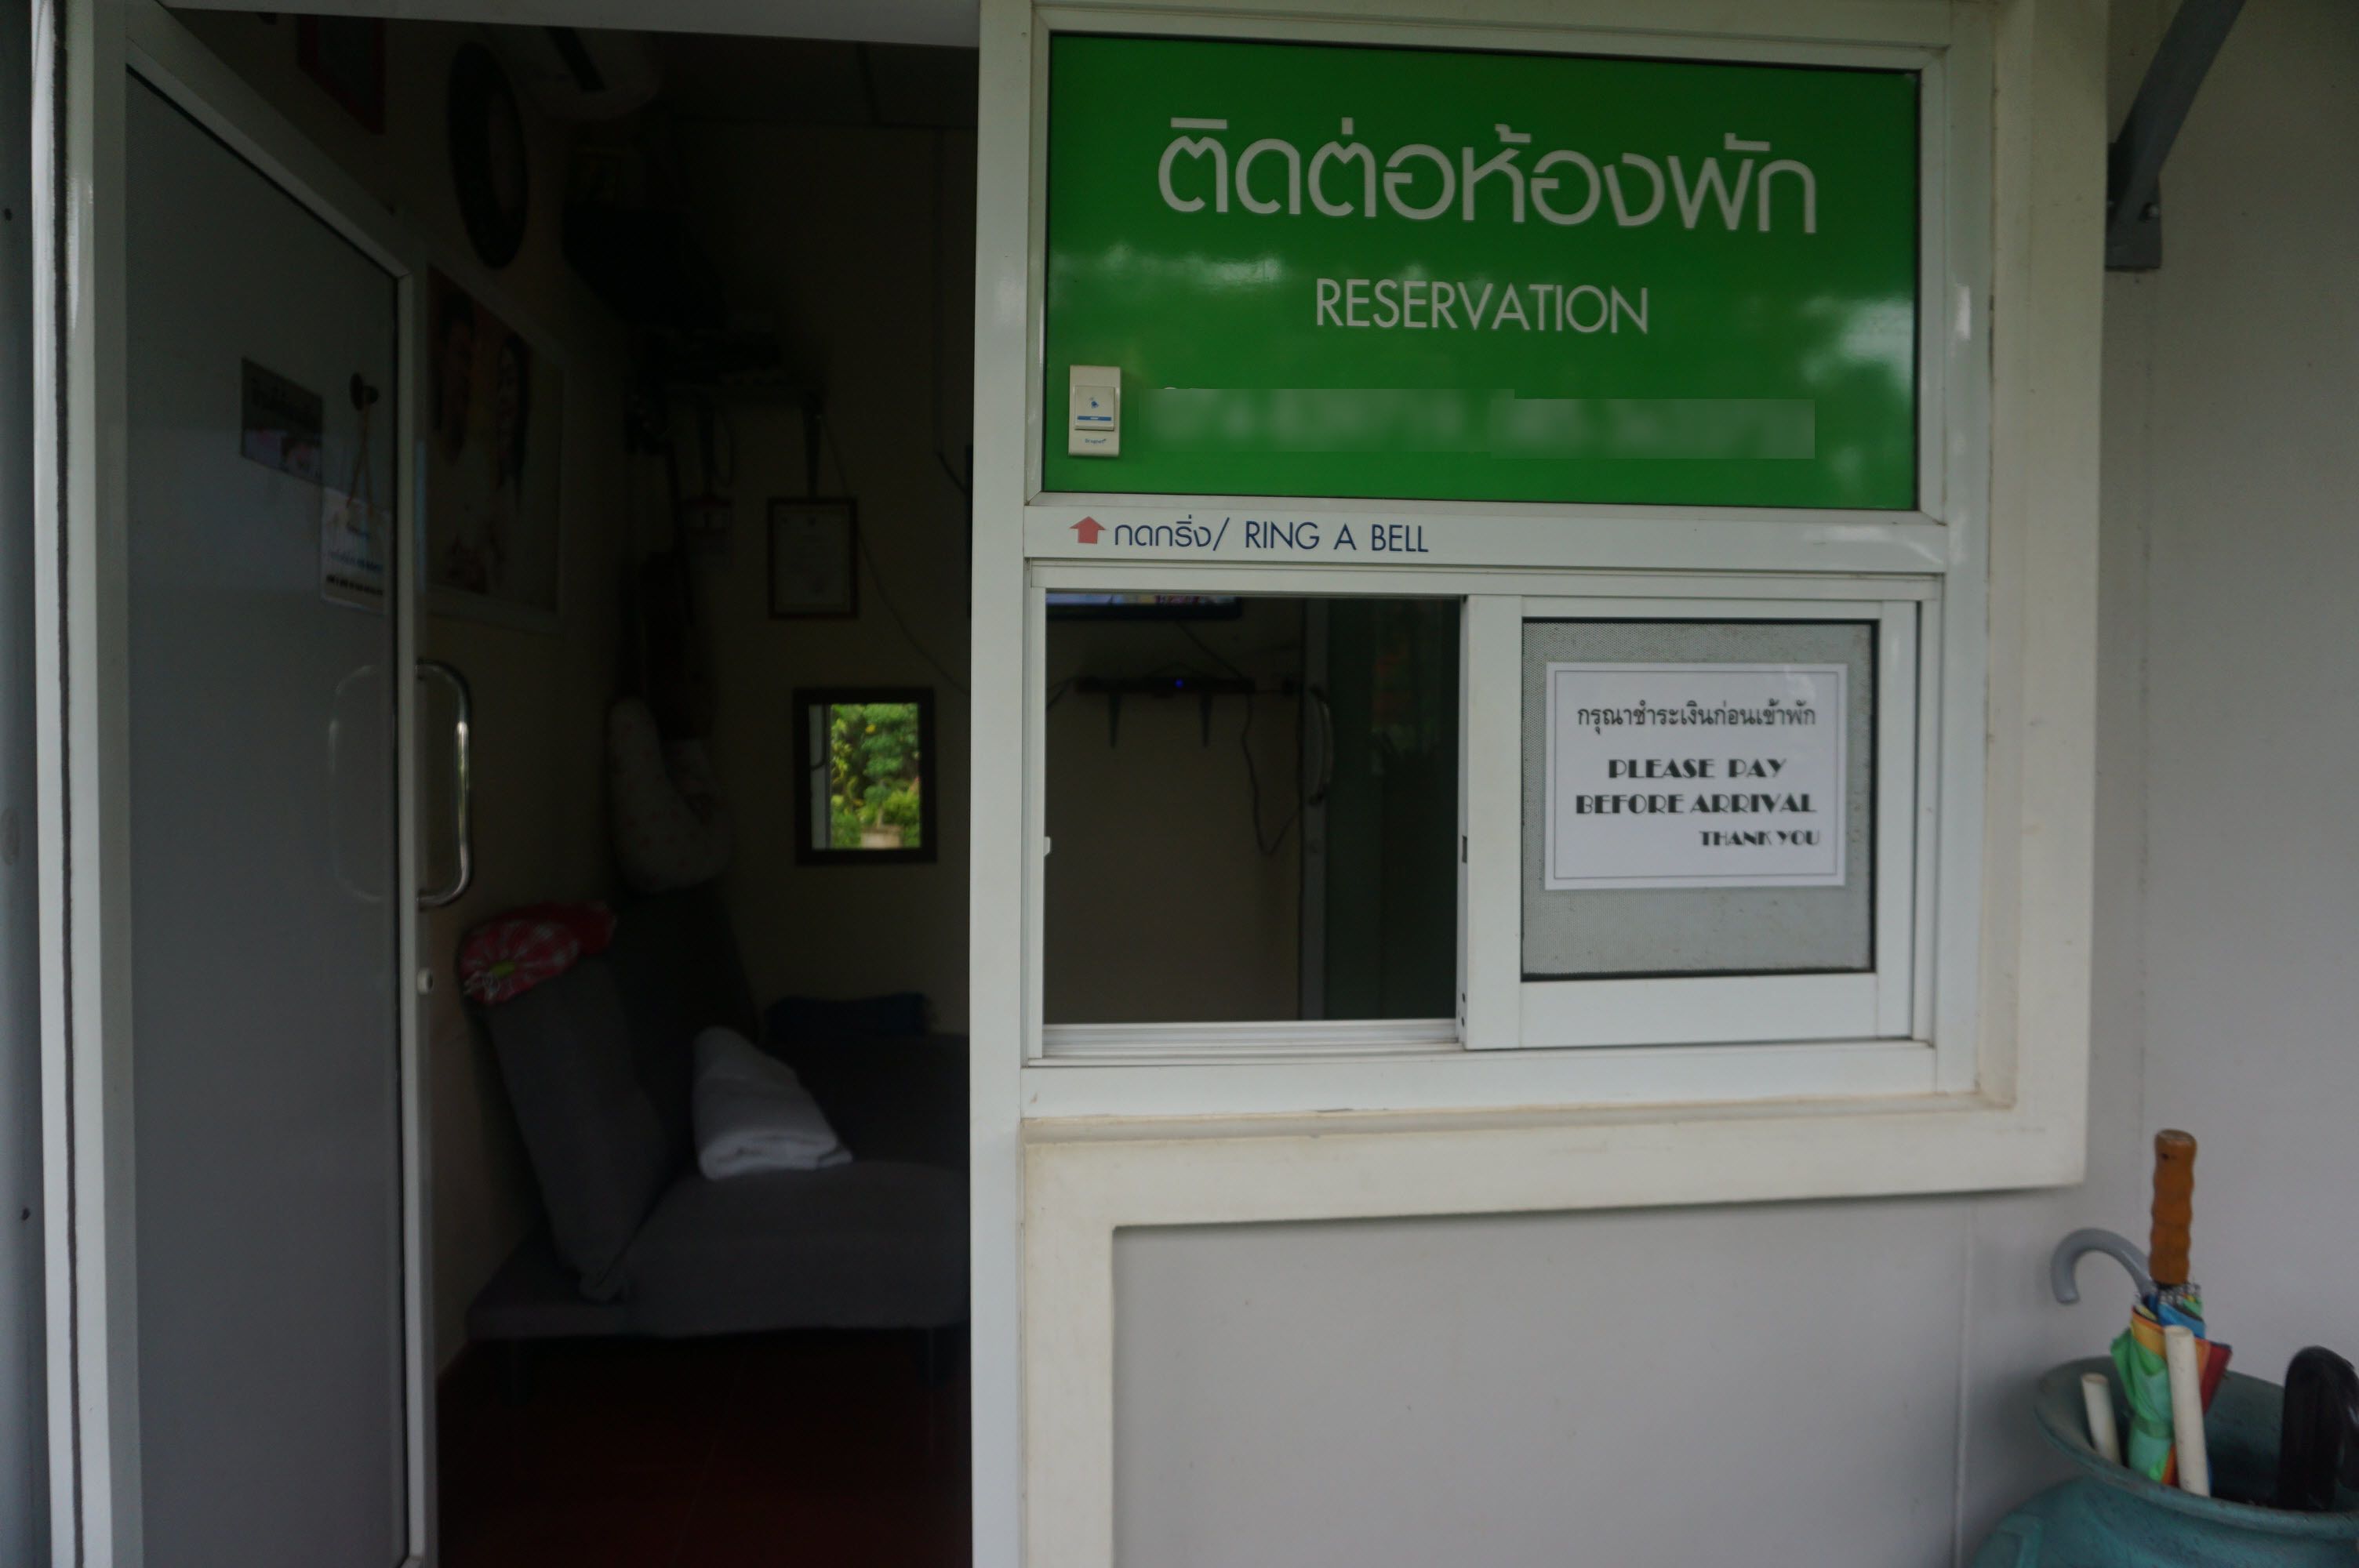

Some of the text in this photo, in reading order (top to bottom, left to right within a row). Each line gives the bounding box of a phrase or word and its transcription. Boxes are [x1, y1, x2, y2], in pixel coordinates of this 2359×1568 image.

[1158, 117, 1818, 234] ติดต่อห้องพัก
[1315, 277, 1650, 335] RESERVATION
[1245, 520, 1321, 550] RING
[1333, 522, 1358, 551] A
[1371, 524, 1430, 554] BELL
[1576, 698, 1817, 735] กรุณาชำระเงินก่อนเข้าพัก
[1608, 758, 1787, 779] PLEASE PAY
[1576, 793, 1818, 815] BEFORE ARRIVAL
[1699, 829, 1821, 847] THANK YOU
